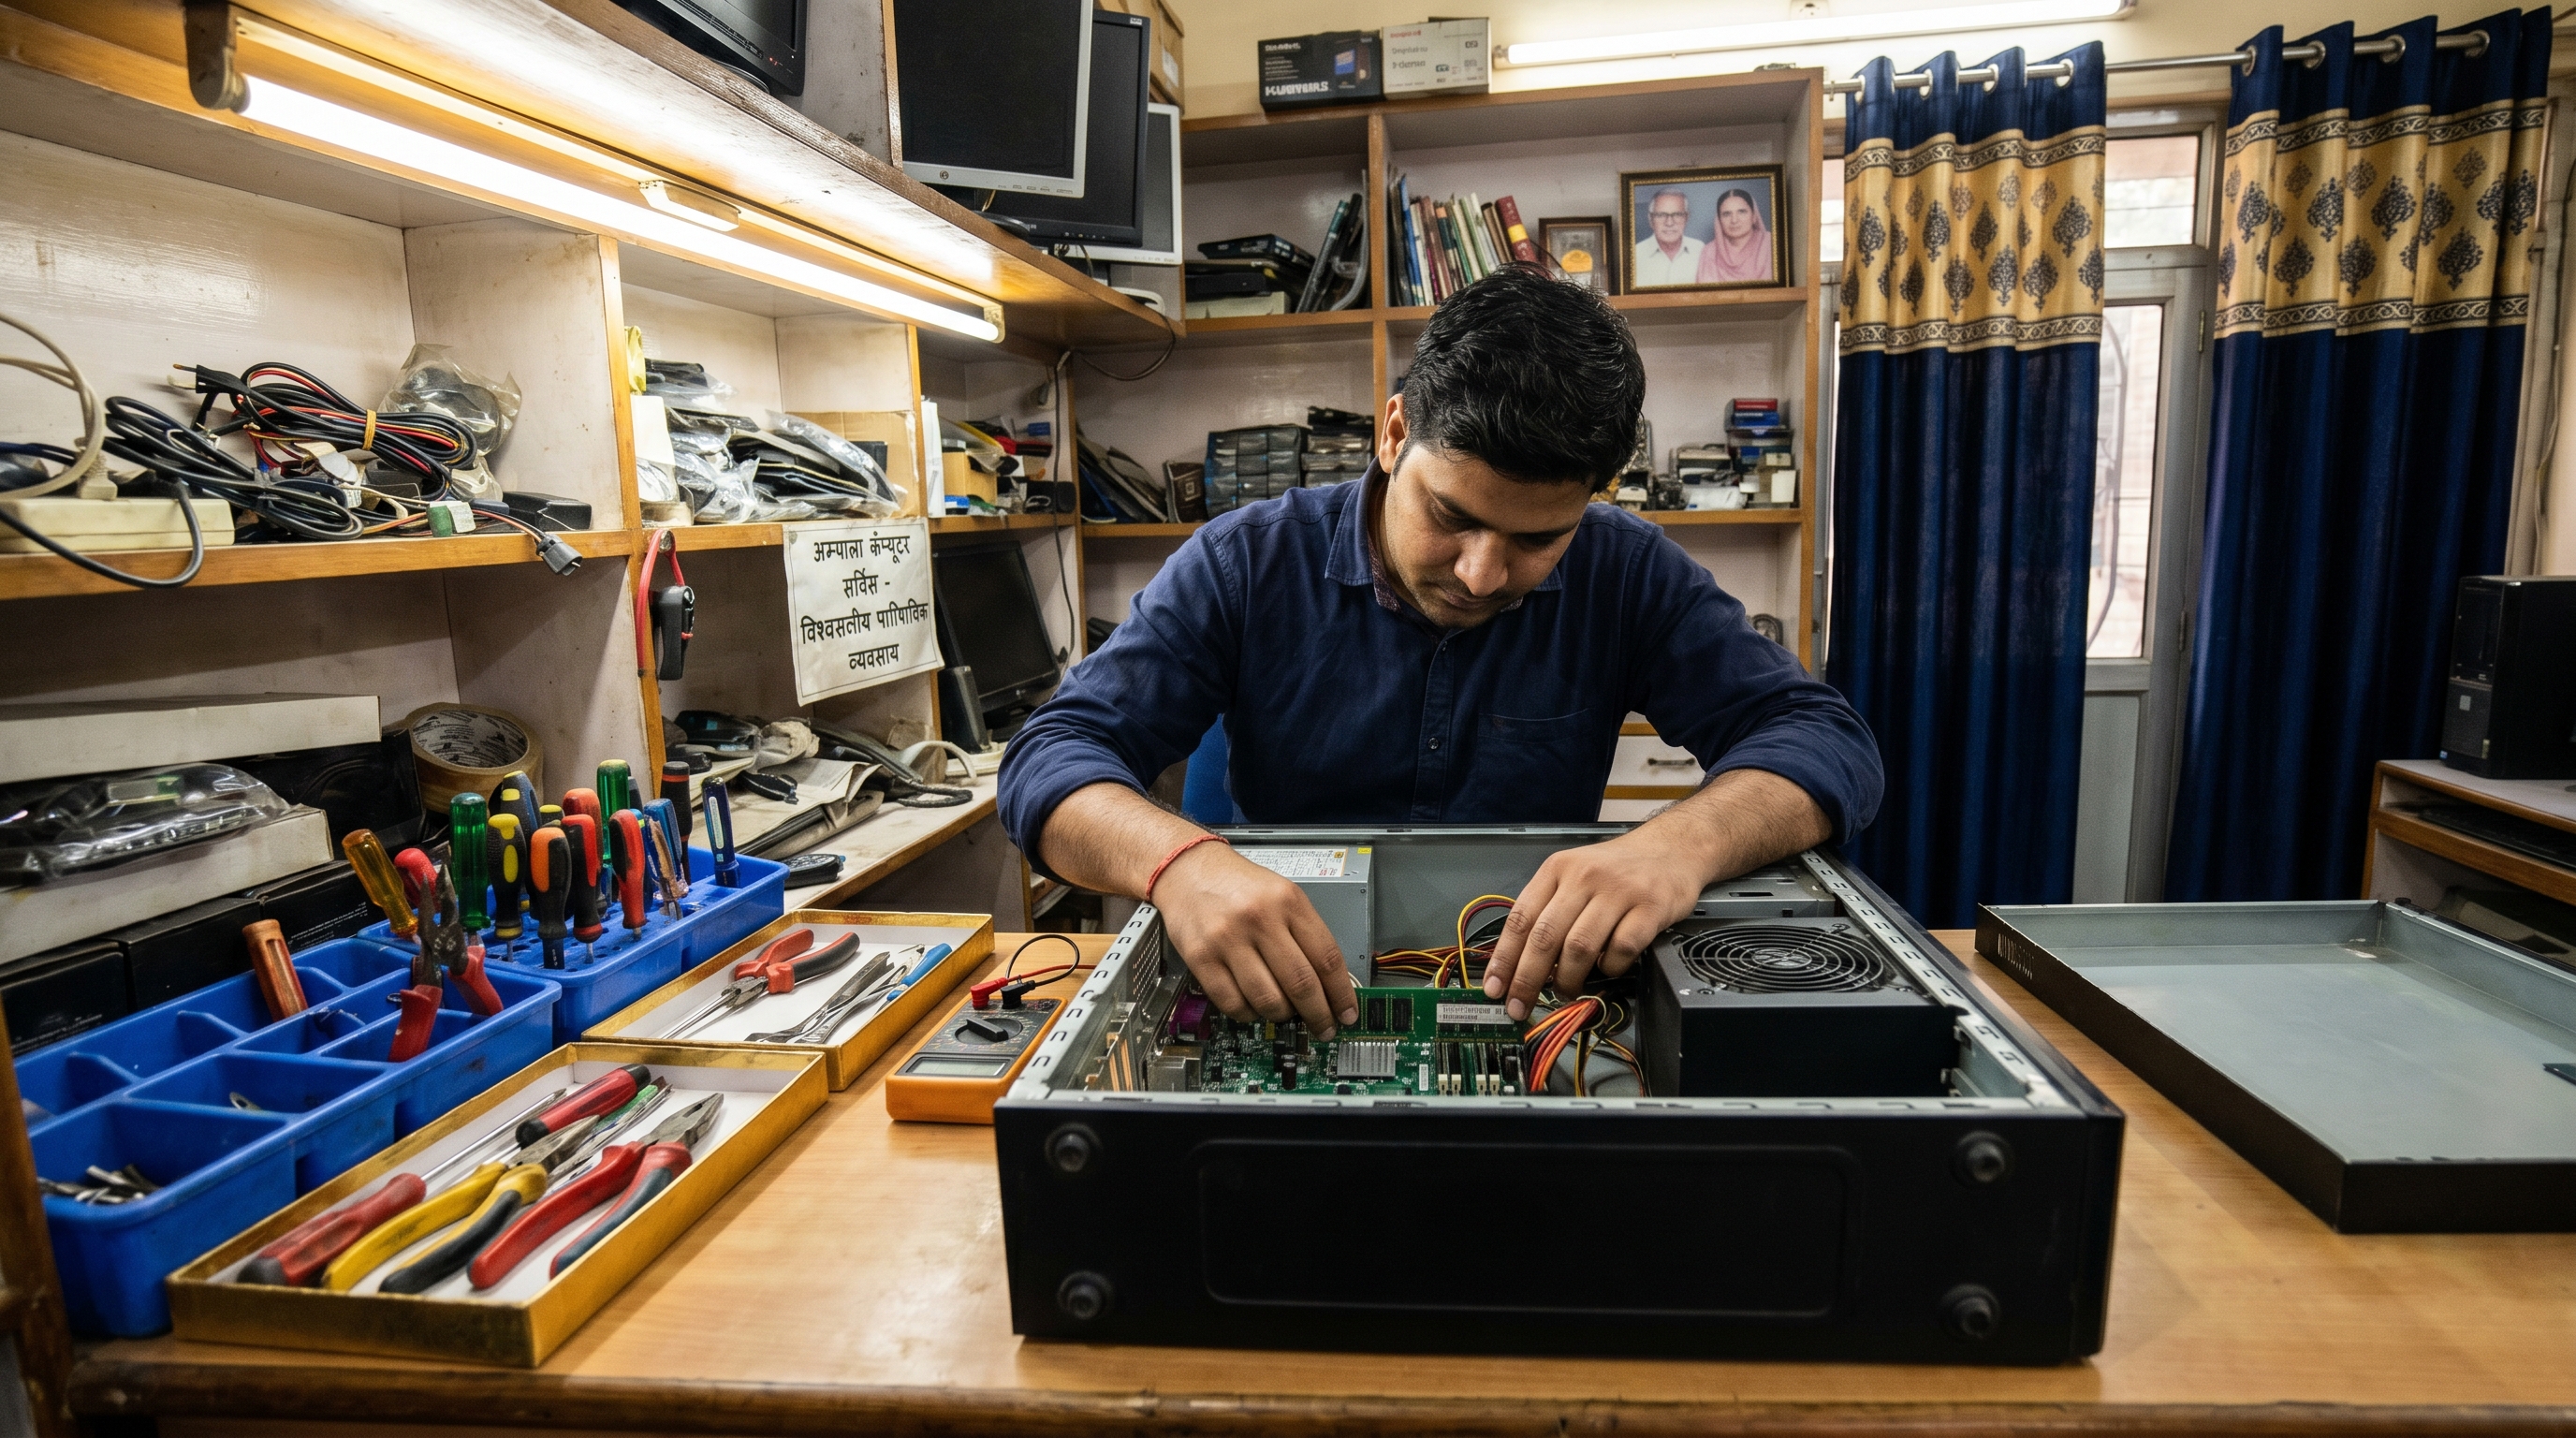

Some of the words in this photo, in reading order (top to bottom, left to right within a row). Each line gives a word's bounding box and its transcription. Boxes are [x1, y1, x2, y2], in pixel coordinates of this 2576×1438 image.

[870, 531, 911, 564] कंप्यूटर
[842, 568, 879, 599] सर्विस
[848, 643, 900, 670] व्यवसाय
